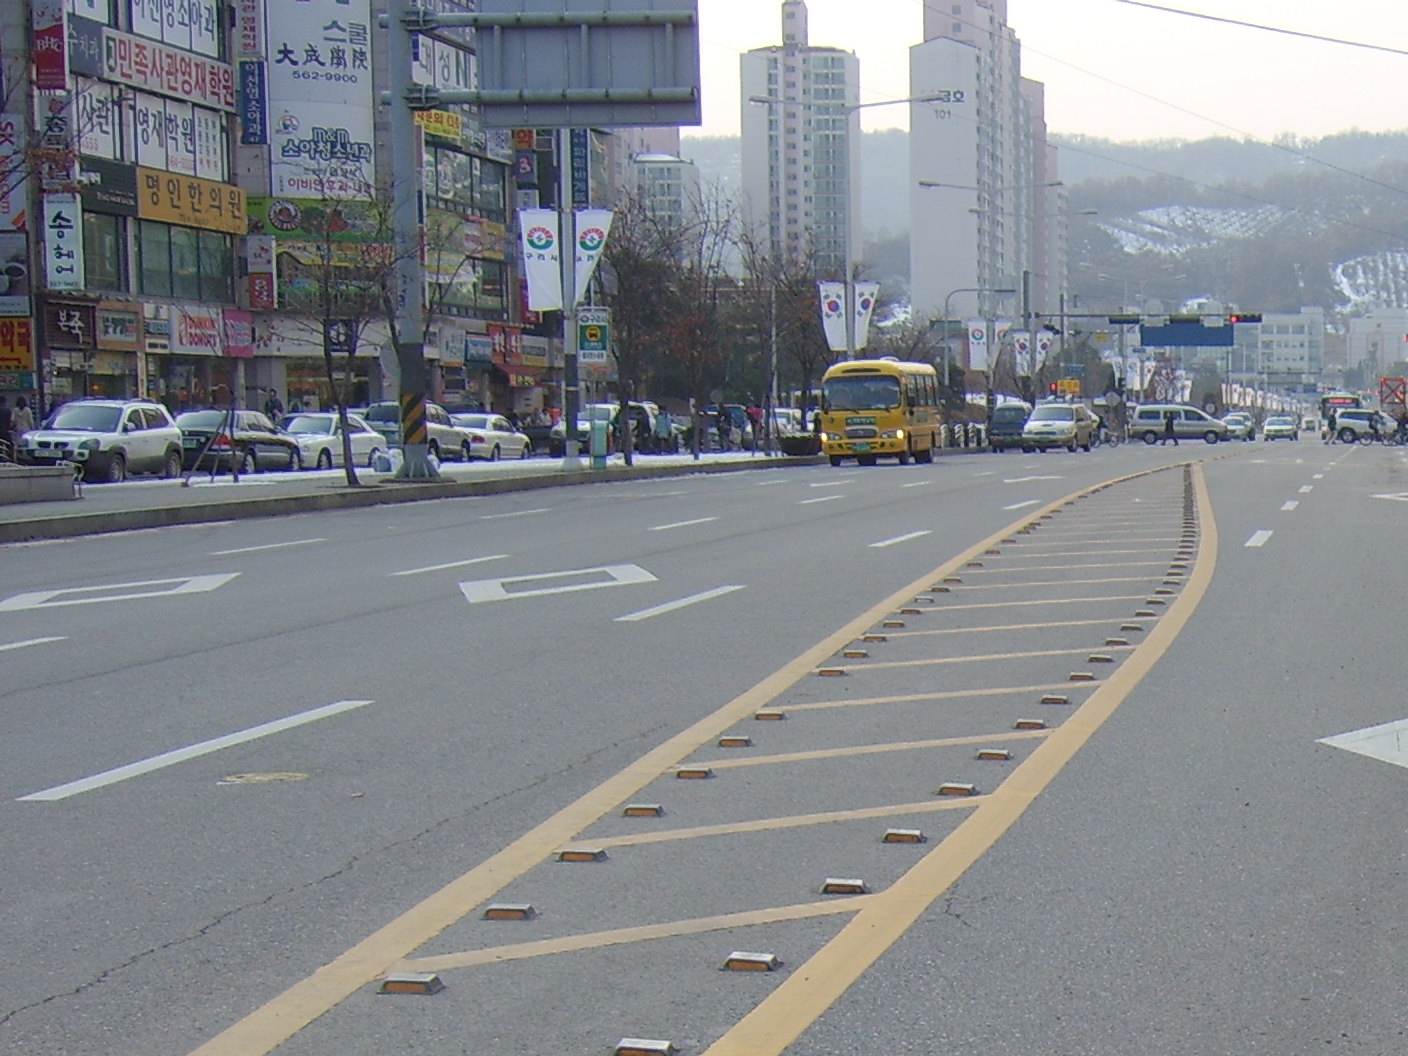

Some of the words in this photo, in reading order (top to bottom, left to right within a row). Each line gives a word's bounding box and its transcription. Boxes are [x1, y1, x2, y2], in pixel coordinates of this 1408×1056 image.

[37, 36, 62, 52] BHC
[323, 20, 368, 46] 스쿨
[118, 39, 234, 107] 민족사관영재학원
[292, 70, 358, 83] 562-9900
[934, 110, 952, 119] 101
[281, 138, 372, 163] 소아청소년과
[145, 174, 242, 219] 명인한의원
[56, 309, 85, 344] 본죽
